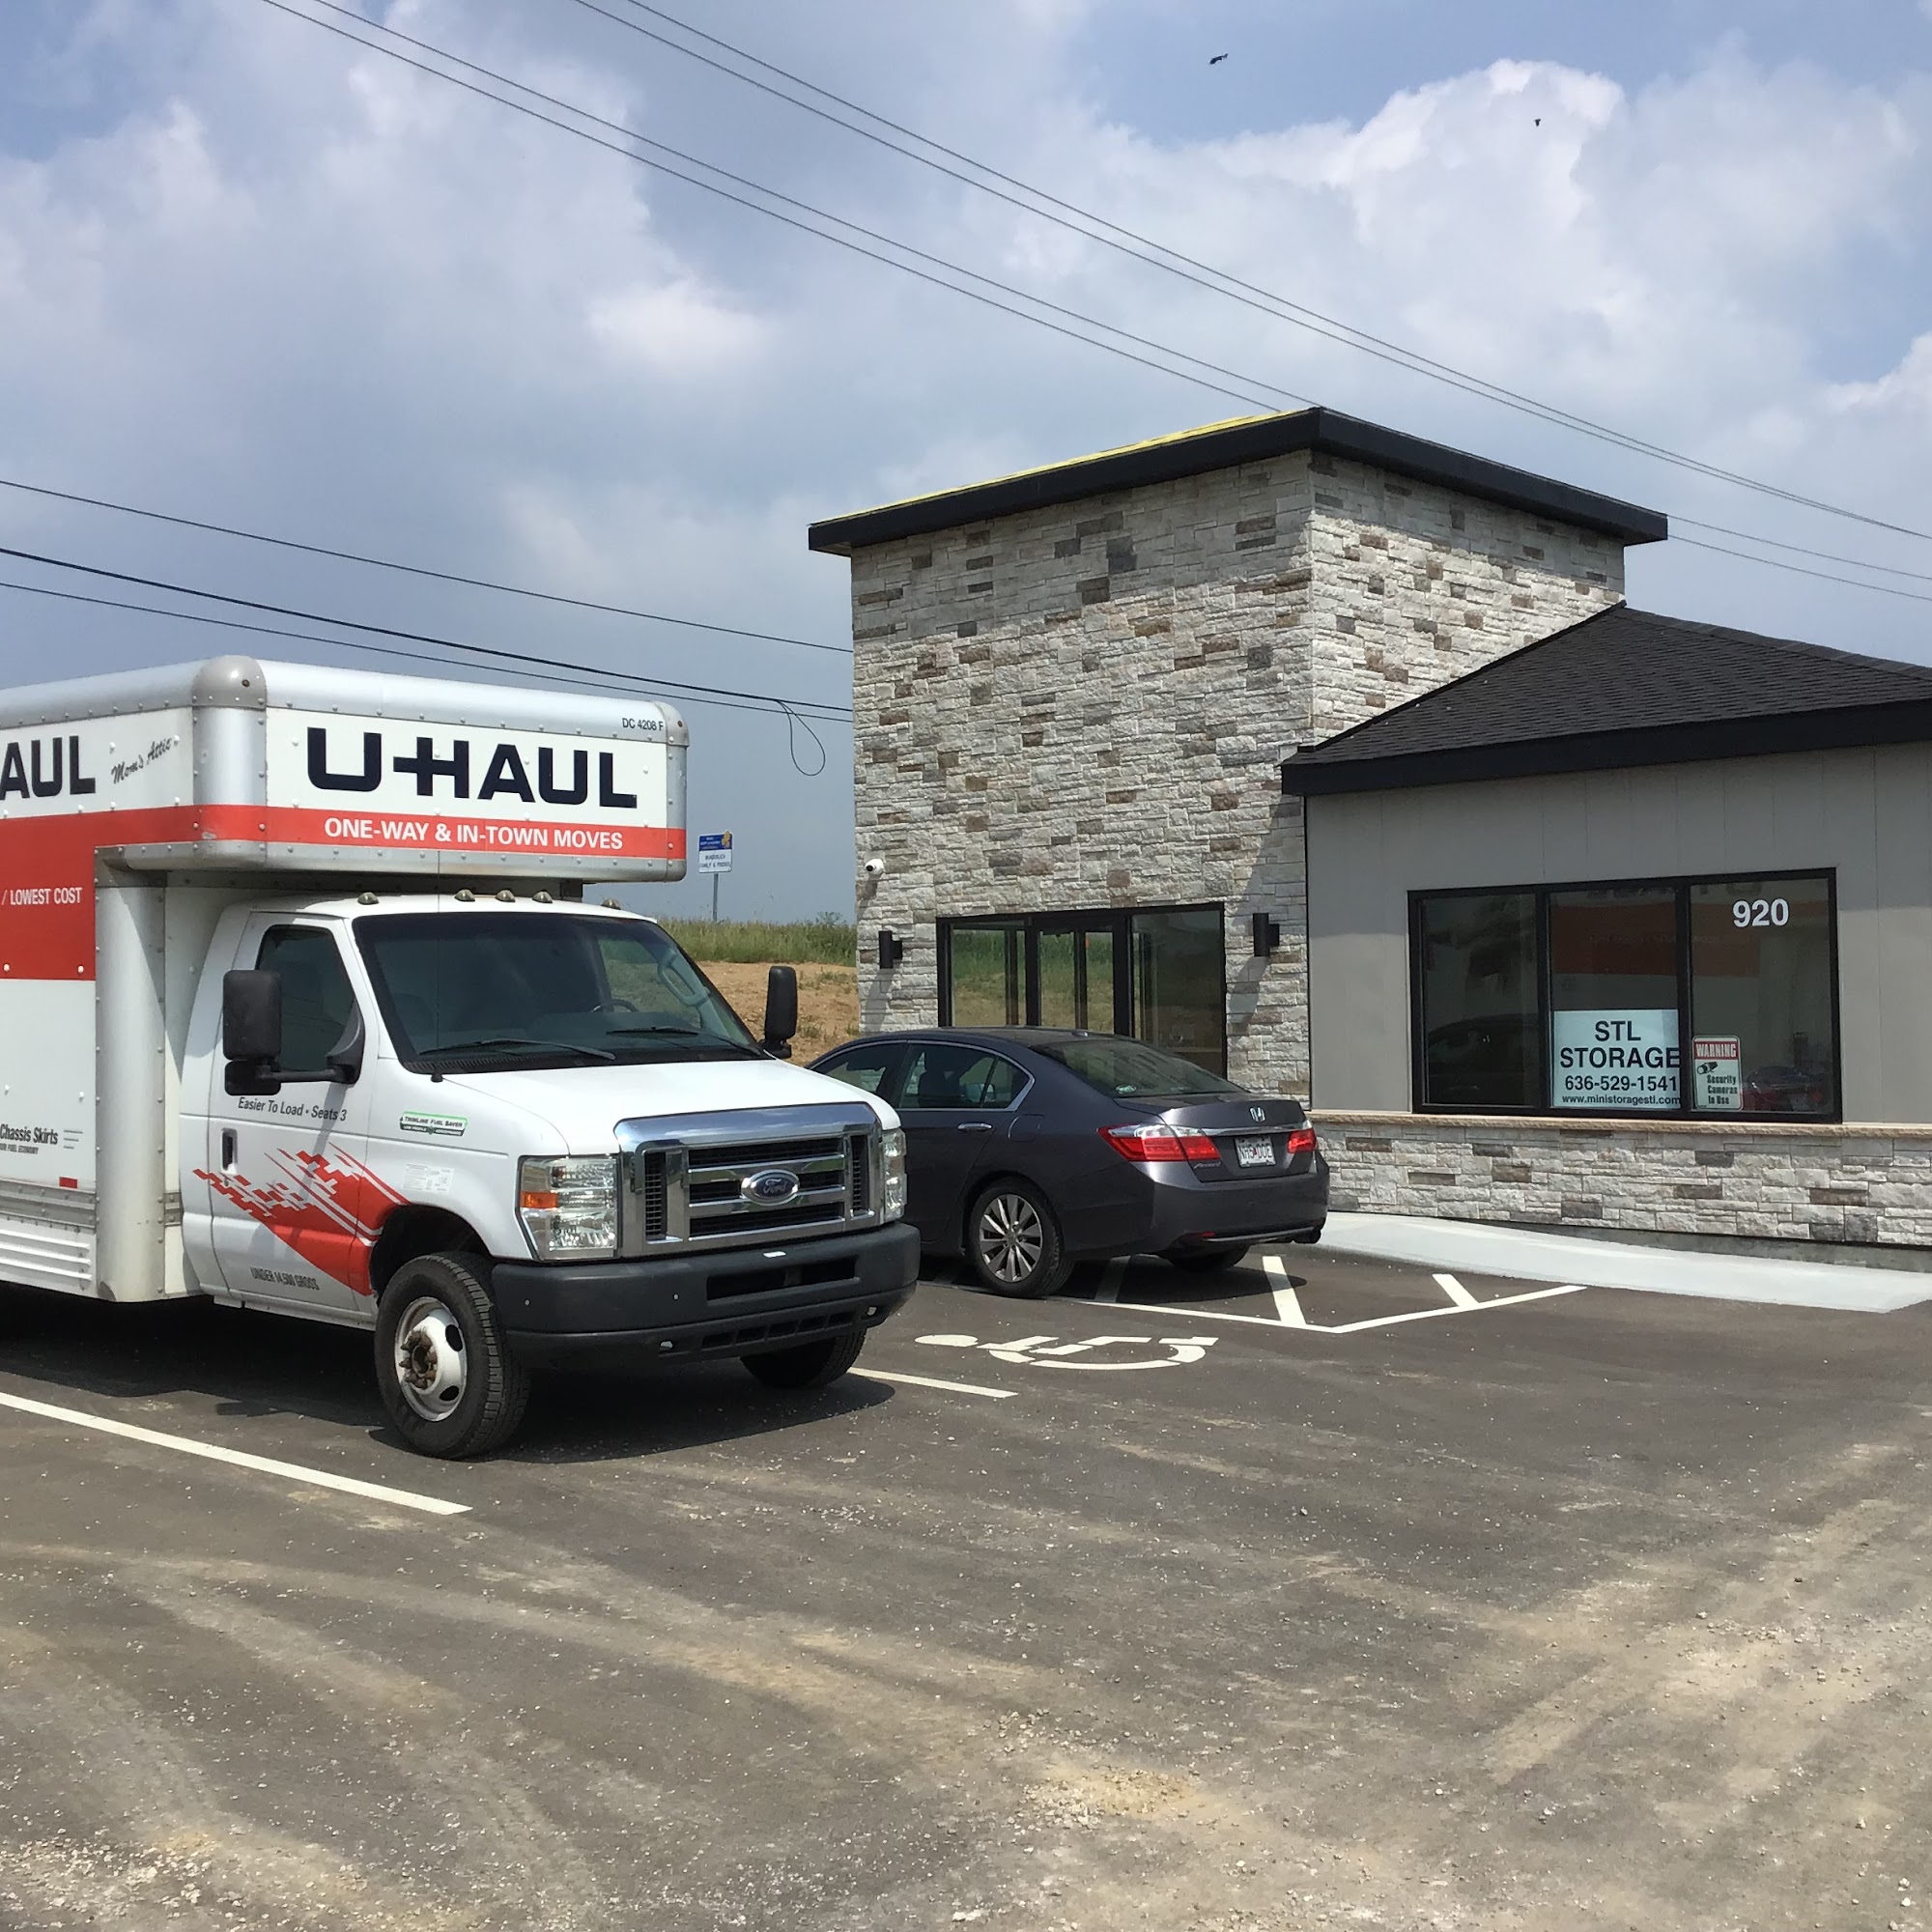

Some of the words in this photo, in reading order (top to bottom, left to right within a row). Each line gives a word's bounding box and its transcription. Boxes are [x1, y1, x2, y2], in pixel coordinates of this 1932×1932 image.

[621, 717, 636, 728] DC
[638, 719, 657, 730] 4208
[658, 721, 664, 731] F
[0, 735, 96, 800] AUL
[111, 754, 144, 784] Mom's
[146, 737, 172, 765] Attic
[325, 816, 430, 842] ONE-WAY
[435, 821, 451, 842] &
[457, 823, 548, 847] IN-TOWN
[554, 829, 623, 851] MOVES
[10, 888, 51, 905] LOWEST
[53, 887, 83, 904] COST
[1732, 897, 1789, 927] 920
[1594, 1020, 1641, 1041] STL
[1559, 1047, 1680, 1068] STORAGE
[1695, 1043, 1737, 1058] WARNING
[1565, 1075, 1677, 1092] 636-529-1541
[1707, 1074, 1736, 1085] Security
[1707, 1085, 1738, 1094] Cameras
[1562, 1094, 1680, 1105] www.ministoragestl.com
[1708, 1095, 1715, 1104] In
[1717, 1095, 1729, 1104] Use
[238, 1096, 266, 1111] Easier
[268, 1099, 278, 1113] To
[280, 1101, 304, 1117] Load
[310, 1105, 338, 1121] Seats
[340, 1109, 348, 1122] 3
[405, 1116, 429, 1124] TRIMLINE
[0, 1123, 32, 1142] Chassis
[33, 1126, 59, 1145] Skirts
[763, 1179, 787, 1194] Ford
[250, 1266, 275, 1283] UNDER
[295, 1274, 321, 1292] GROSS
